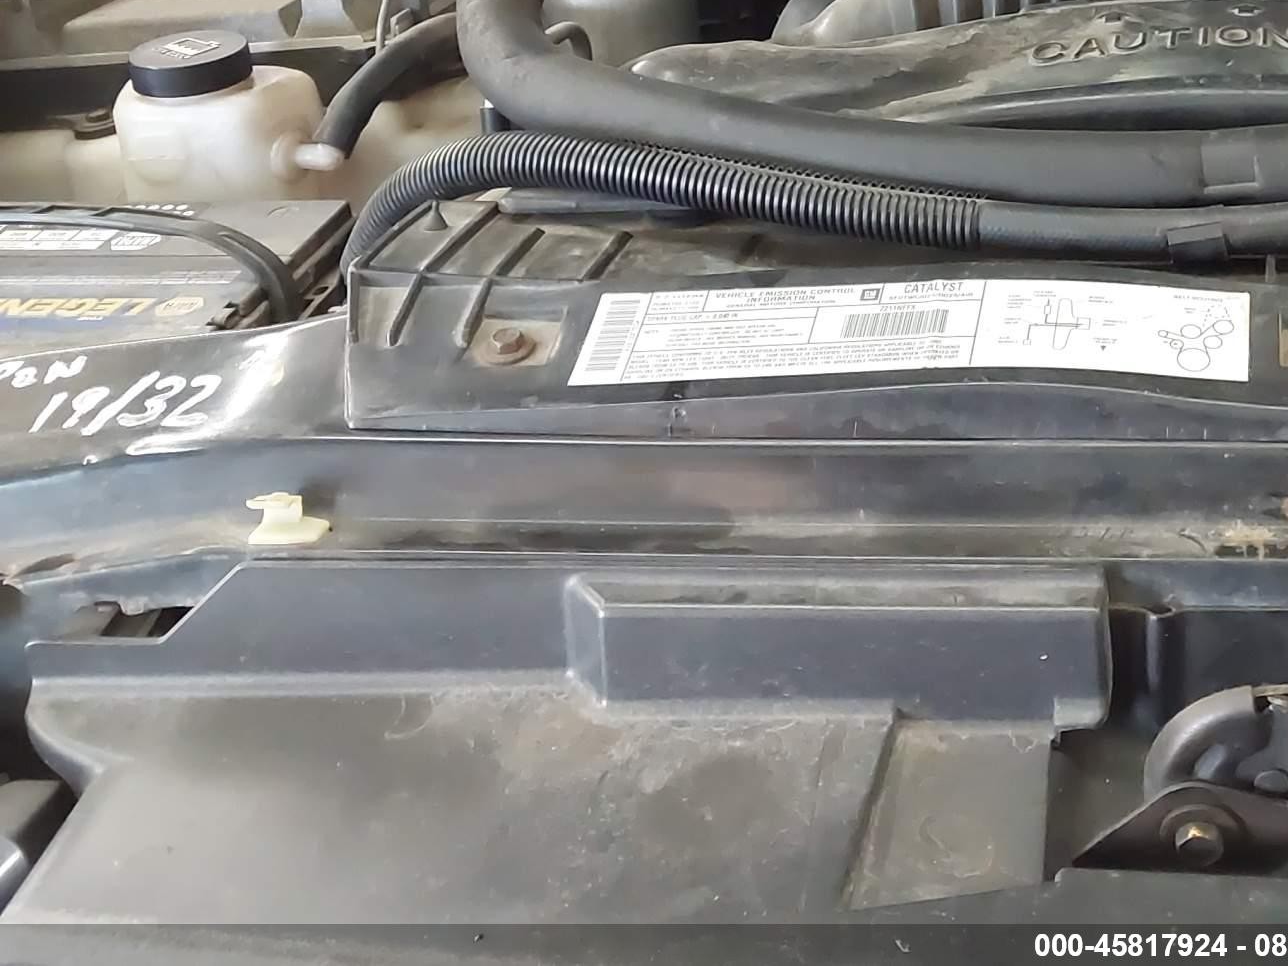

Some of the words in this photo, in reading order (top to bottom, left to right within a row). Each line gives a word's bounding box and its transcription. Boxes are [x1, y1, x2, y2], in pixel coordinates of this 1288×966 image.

[759, 289, 808, 297] EMISSION
[810, 287, 854, 295] CONTROL
[904, 282, 963, 294] CATALYST
[746, 294, 816, 303] INFORMATION
[28, 370, 223, 437] 19/32
